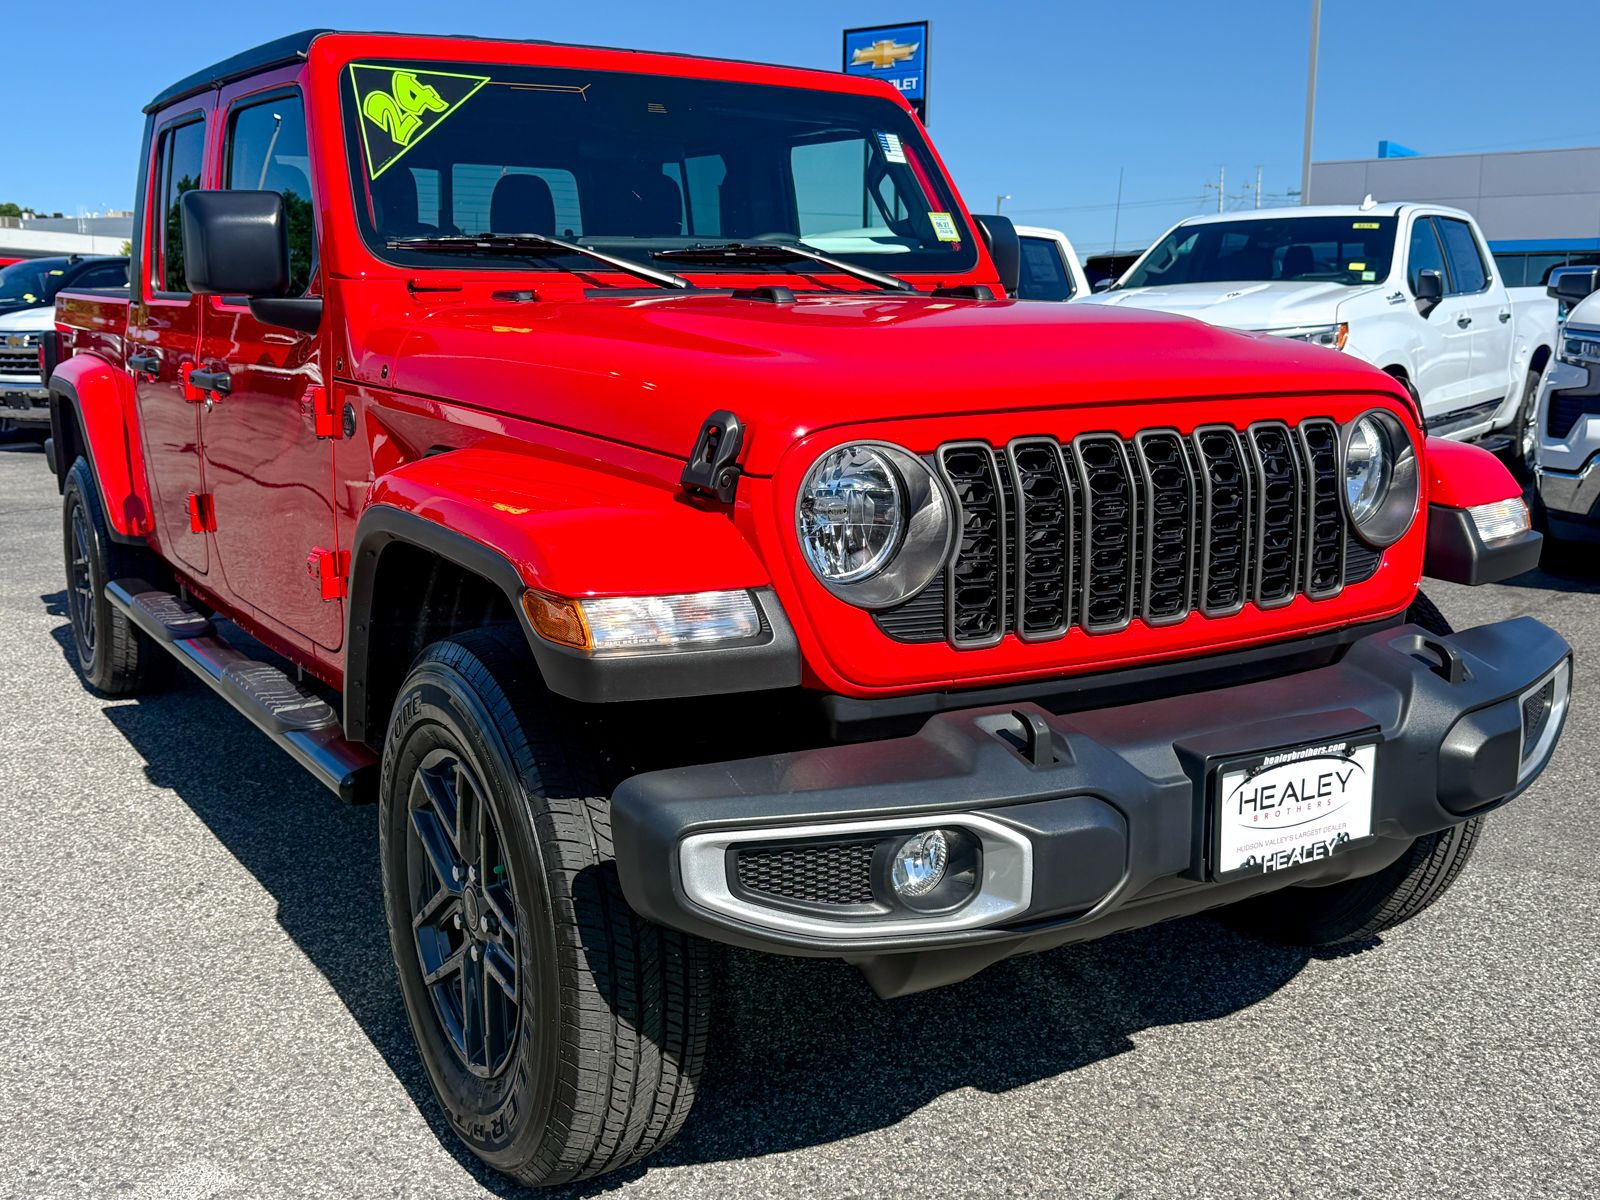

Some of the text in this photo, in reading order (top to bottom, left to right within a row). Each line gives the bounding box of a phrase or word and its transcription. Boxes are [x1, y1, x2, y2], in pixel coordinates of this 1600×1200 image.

[363, 70, 450, 146] 24
[1263, 742, 1347, 766] healeybrothers.com
[1238, 768, 1354, 815] HEALEY
[1253, 798, 1332, 822] BROTHERS
[1236, 842, 1264, 853] HUDSON
[1294, 828, 1322, 840] LARGEST
[1323, 822, 1347, 833] DEALER
[1262, 838, 1337, 873] HEALEY
